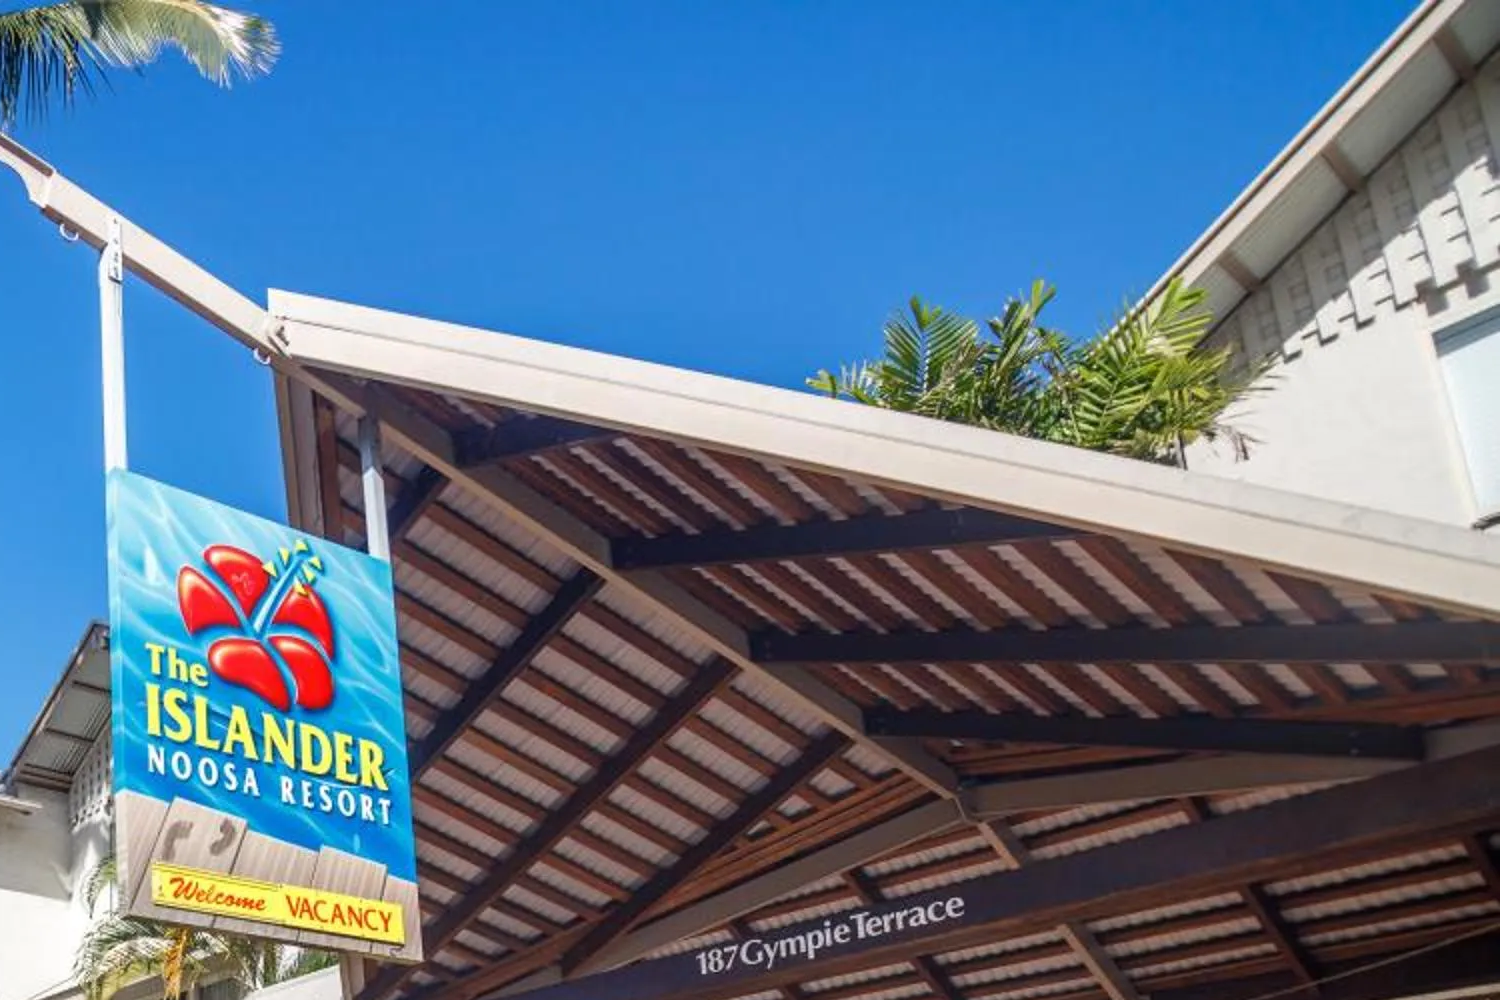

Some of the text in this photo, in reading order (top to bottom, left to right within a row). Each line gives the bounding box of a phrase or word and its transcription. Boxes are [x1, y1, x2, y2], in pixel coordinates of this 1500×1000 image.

[145, 642, 208, 688] The
[145, 682, 389, 791] ISLANDER
[147, 745, 392, 826] NOOSA RESORT
[169, 877, 393, 933] Welcome VACANCY
[696, 896, 965, 975] 187 Gympie Terrace
